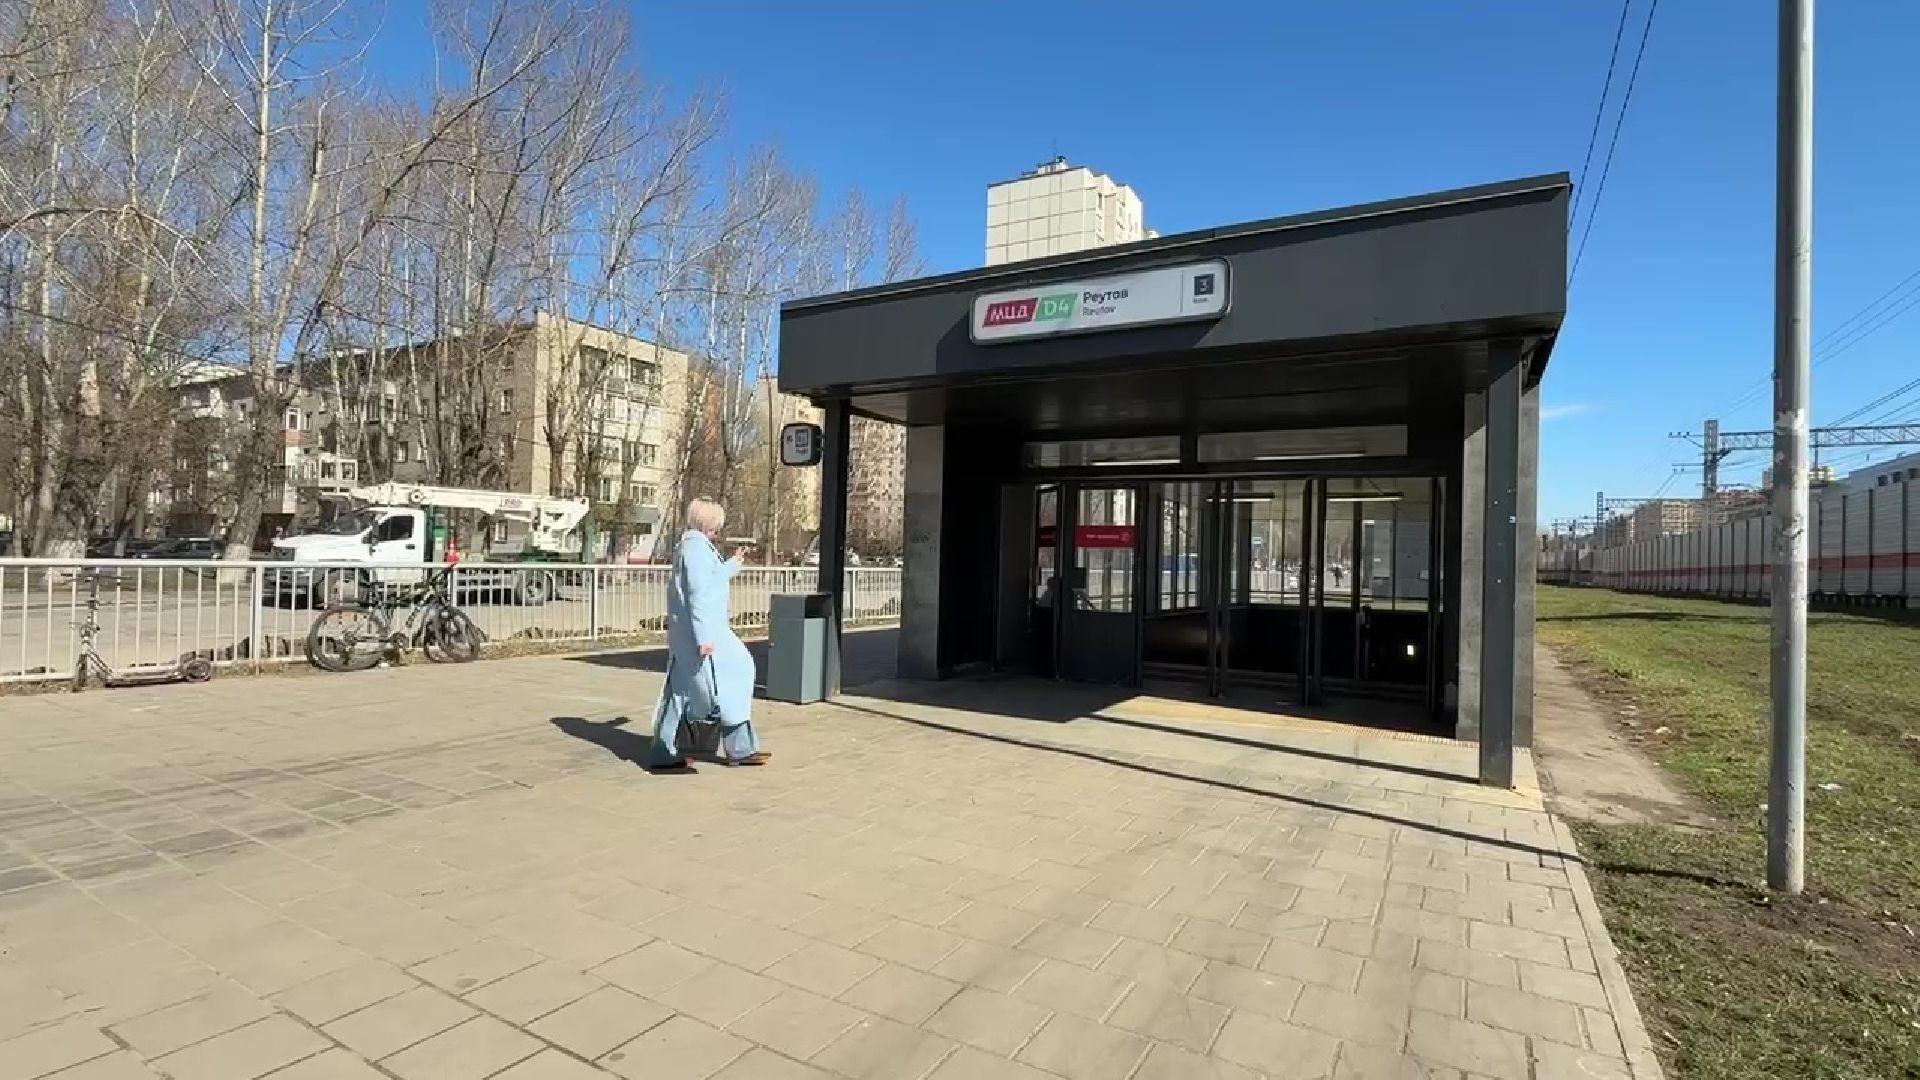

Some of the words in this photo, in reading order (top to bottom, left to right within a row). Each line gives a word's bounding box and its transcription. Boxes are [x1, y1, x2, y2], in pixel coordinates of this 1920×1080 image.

[1083, 289, 1129, 304] Реутов
[990, 305, 1028, 322] МЦД
[1044, 299, 1069, 316] D4
